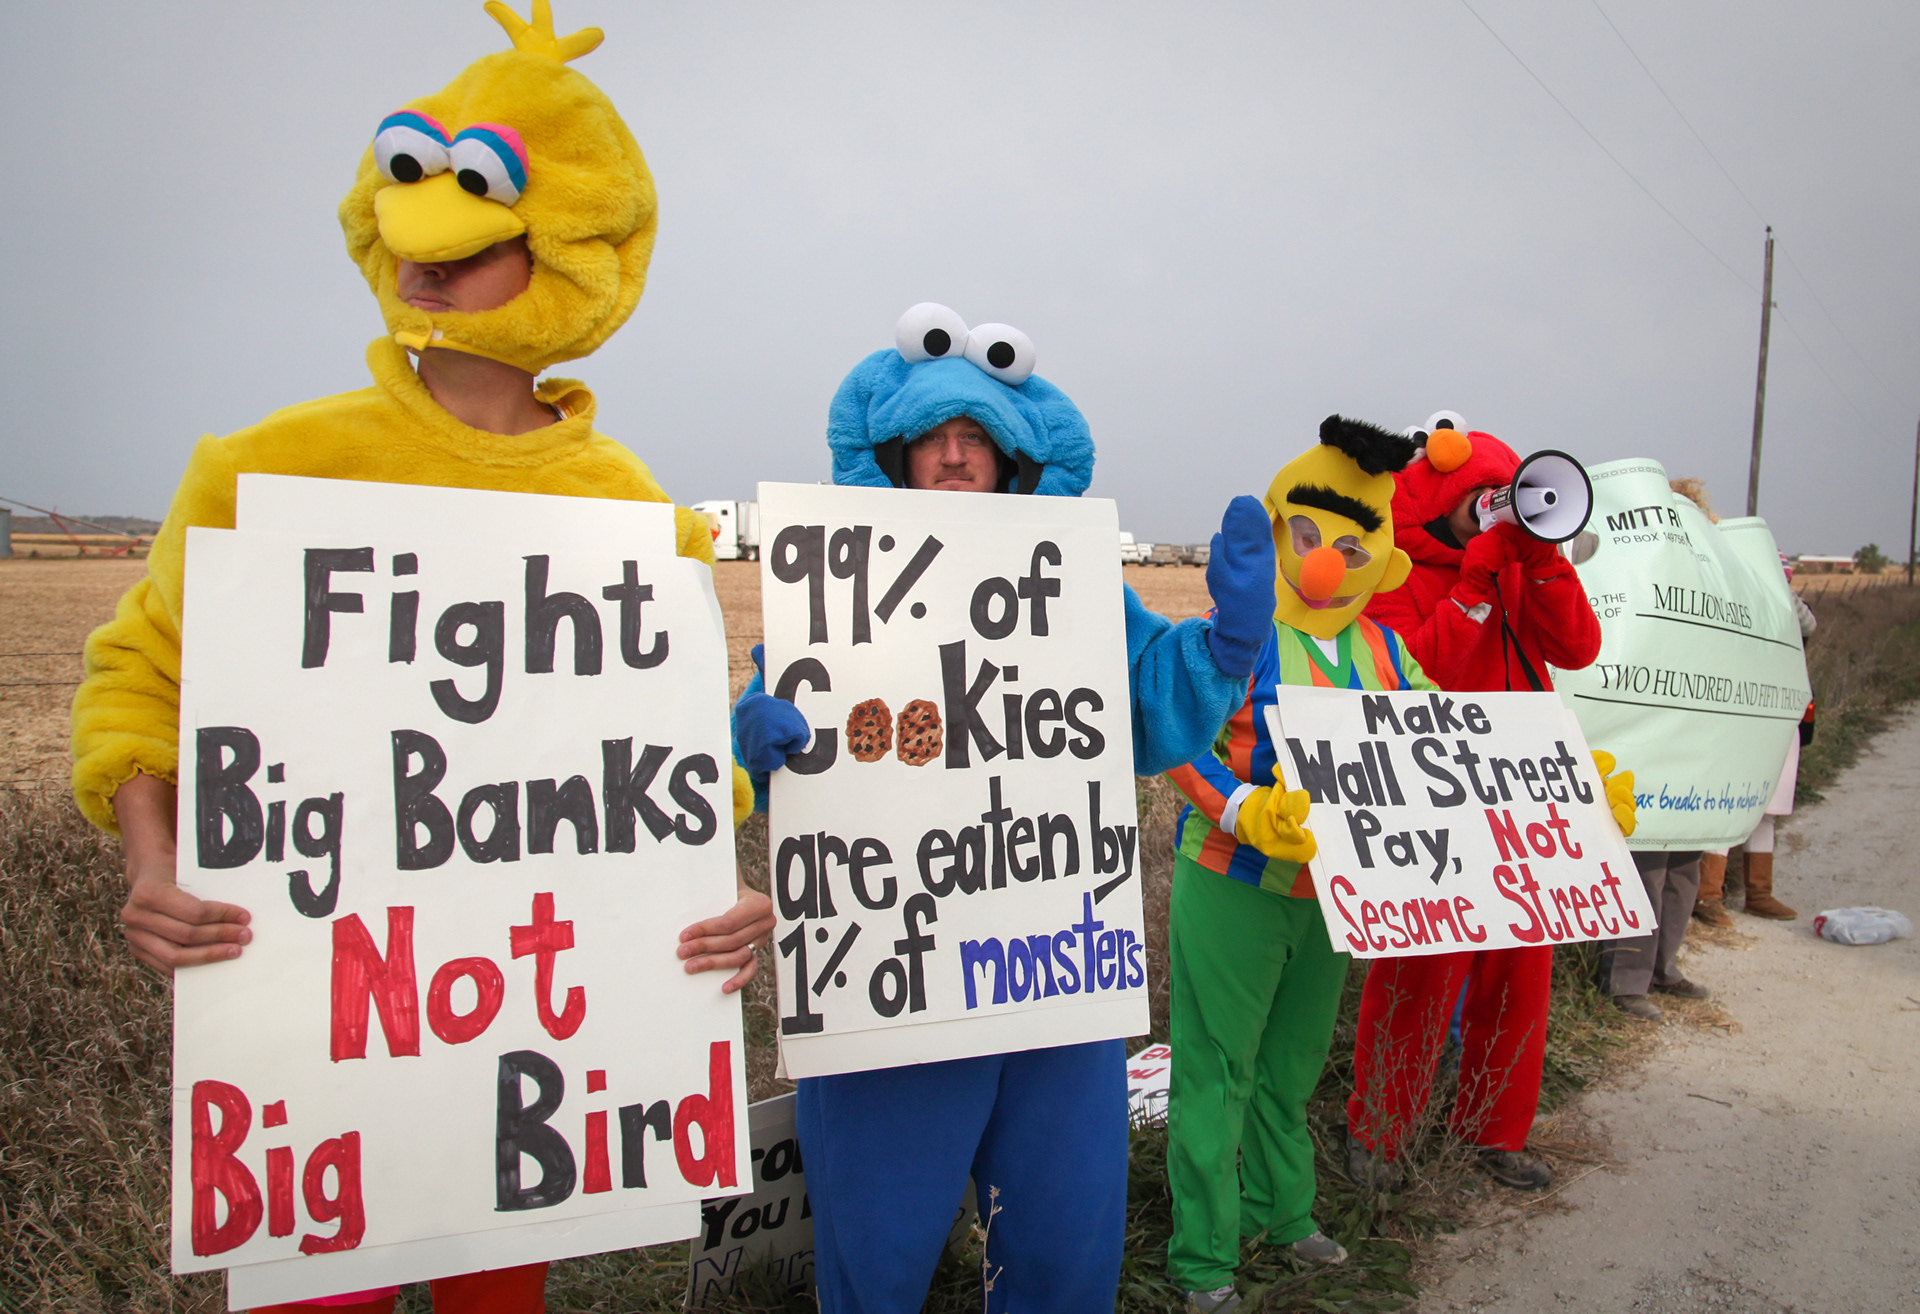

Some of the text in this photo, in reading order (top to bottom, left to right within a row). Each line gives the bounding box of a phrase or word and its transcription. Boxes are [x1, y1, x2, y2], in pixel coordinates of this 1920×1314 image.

[1606, 506, 1663, 532] MITT
[1613, 535, 1632, 545] PO
[1633, 532, 1660, 543] BOX
[770, 524, 1064, 647] 99% of
[1587, 592, 1628, 608] O THE
[1604, 607, 1622, 619] OF
[299, 546, 672, 726] Fight
[1360, 692, 1493, 735] Make
[1596, 663, 1650, 694] TWO
[1652, 669, 1733, 704] HUNDRED
[1733, 681, 1758, 706] AND
[1285, 736, 1595, 808] Wall Street
[1659, 783, 1701, 812] breaks
[1703, 789, 1716, 811] to
[1718, 782, 1735, 815] the
[194, 726, 346, 920] Big
[775, 774, 1138, 923] are eaten by
[1344, 802, 1584, 885] Pay, Not
[1329, 861, 1640, 952] Sesame Street
[328, 888, 588, 1064] Not
[776, 889, 1146, 1036] 1% of monsters
[189, 1038, 740, 1258] Big Bird
[701, 1197, 790, 1252] You
